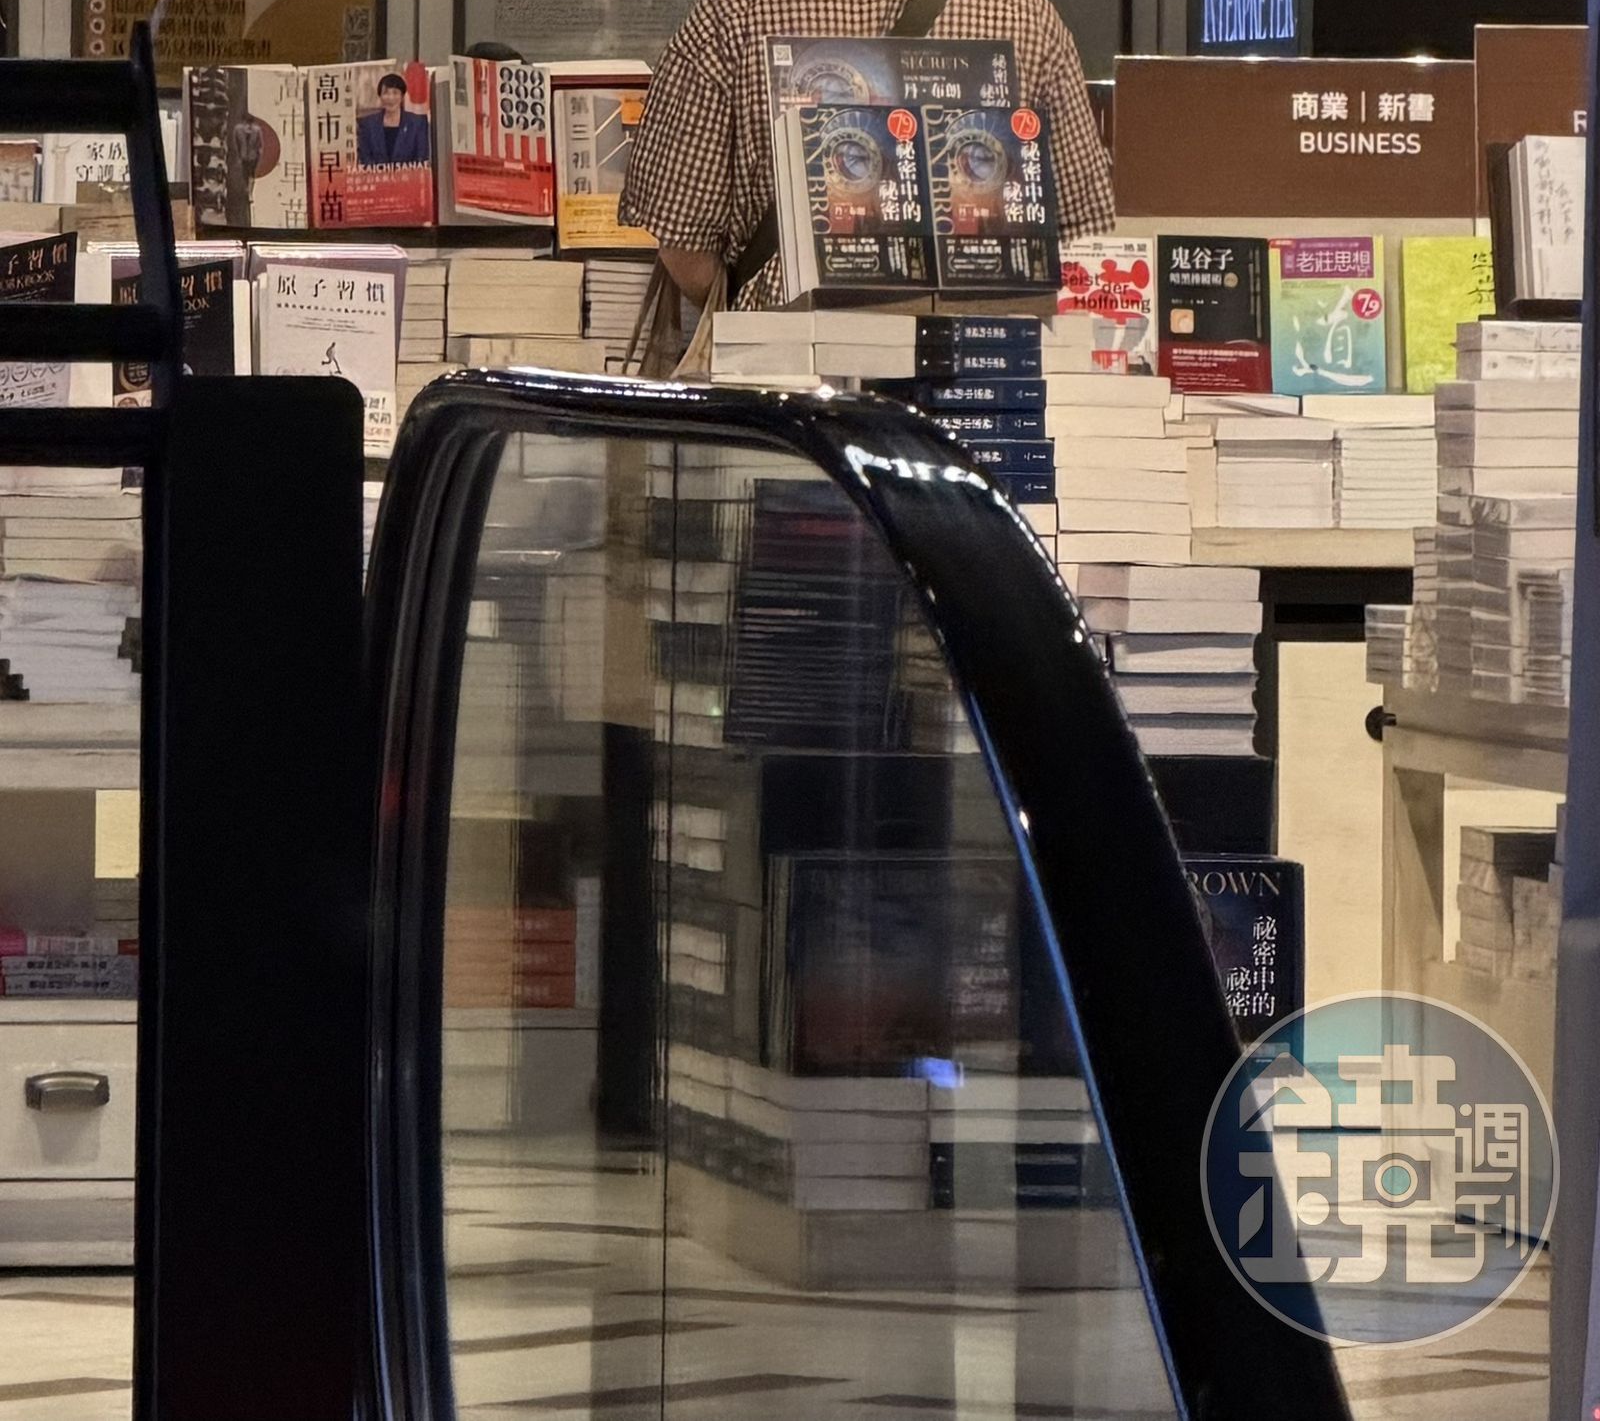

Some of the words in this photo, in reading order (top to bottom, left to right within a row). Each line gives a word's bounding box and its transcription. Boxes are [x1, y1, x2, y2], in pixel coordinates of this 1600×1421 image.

[317, 74, 344, 223] 高市早苗
[1300, 131, 1422, 156] BUSINESS
[1170, 246, 1234, 271] 鬼谷子
[1296, 250, 1372, 276] 老莊思想
[277, 275, 386, 304] 原子習慣
[1102, 283, 1130, 295] der
[1073, 295, 1151, 314] Hoffnung
